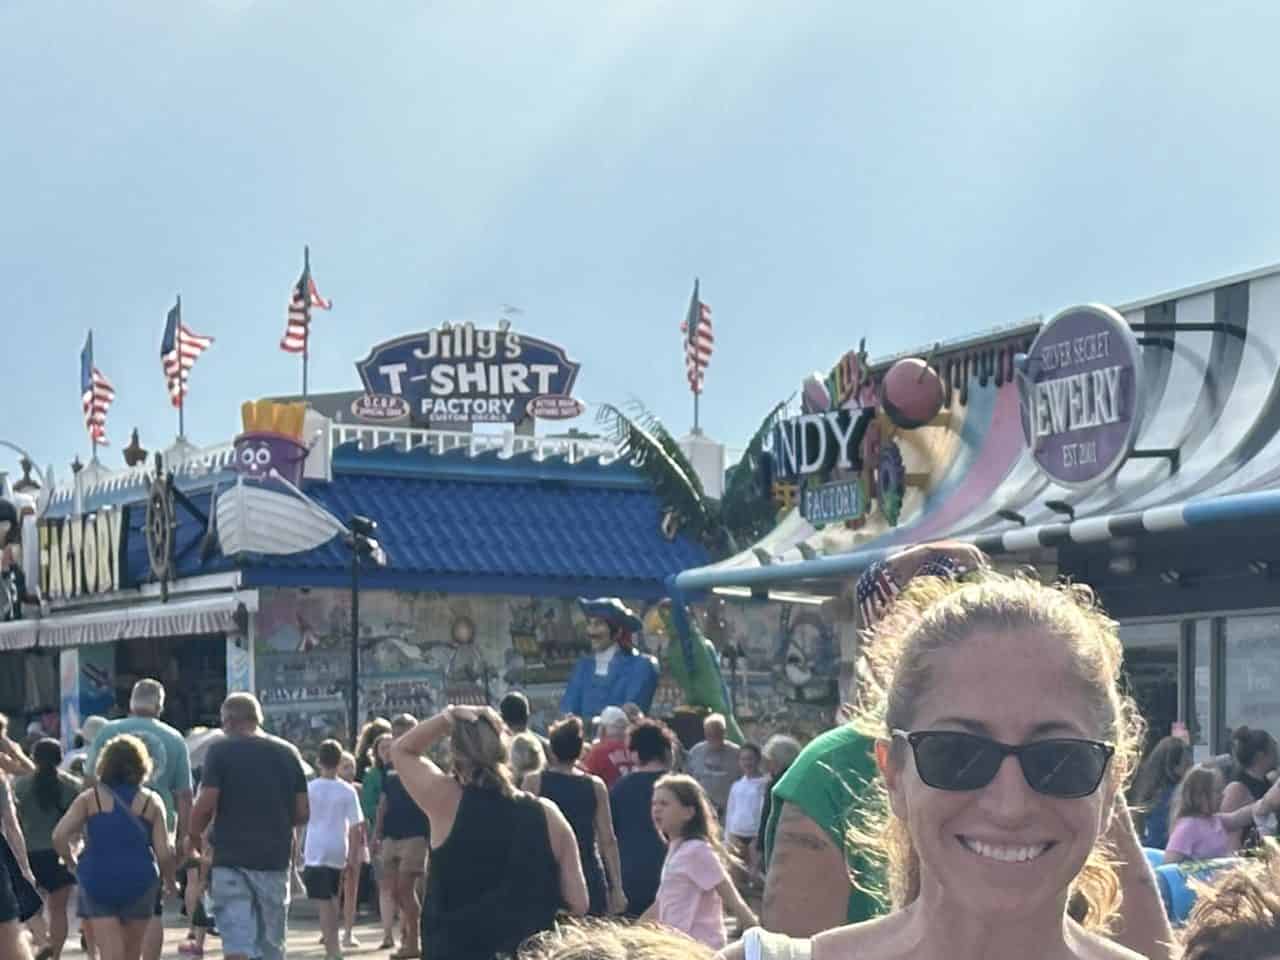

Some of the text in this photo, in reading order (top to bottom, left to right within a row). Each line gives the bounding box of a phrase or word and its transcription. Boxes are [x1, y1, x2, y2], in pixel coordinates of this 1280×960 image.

[412, 320, 522, 360] Jilly's
[378, 362, 559, 396] T-SHIRT
[420, 397, 515, 415] FACTORY
[806, 486, 858, 521] FACTORY
